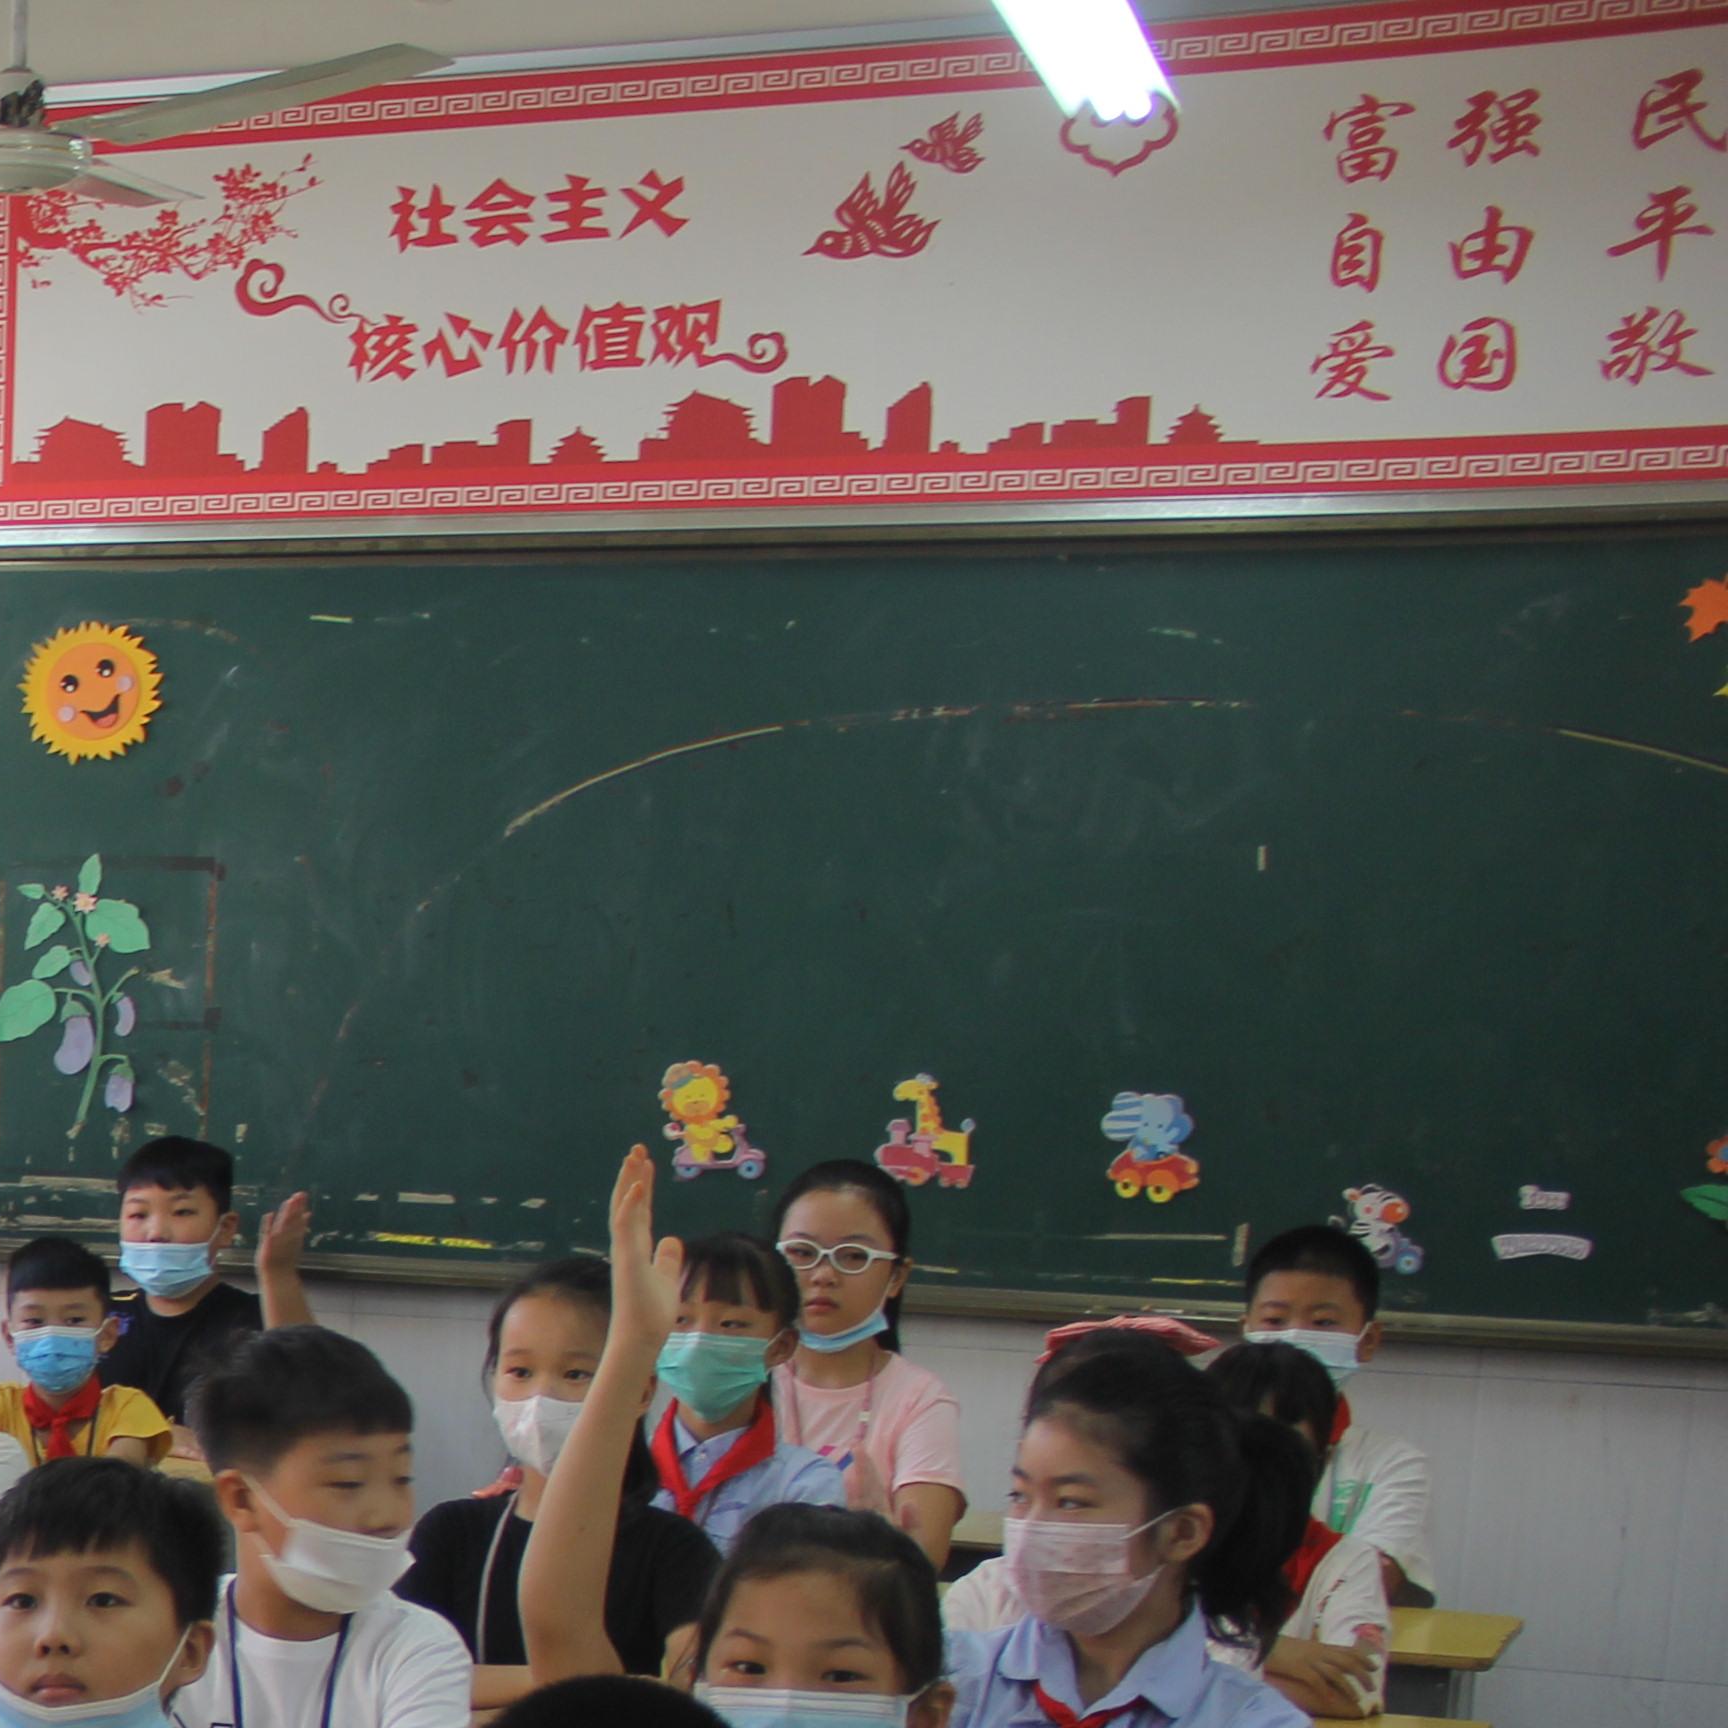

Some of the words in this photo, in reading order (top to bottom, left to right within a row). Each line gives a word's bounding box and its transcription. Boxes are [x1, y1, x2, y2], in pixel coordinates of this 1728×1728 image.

[1322, 88, 1543, 183] 富强
[389, 168, 690, 253] 社会主义
[1328, 205, 1536, 293] 自由
[1608, 185, 1714, 281] 平
[348, 300, 723, 382] 核心价值观
[1310, 316, 1520, 402] 爱国
[1599, 306, 1715, 386] 敬
